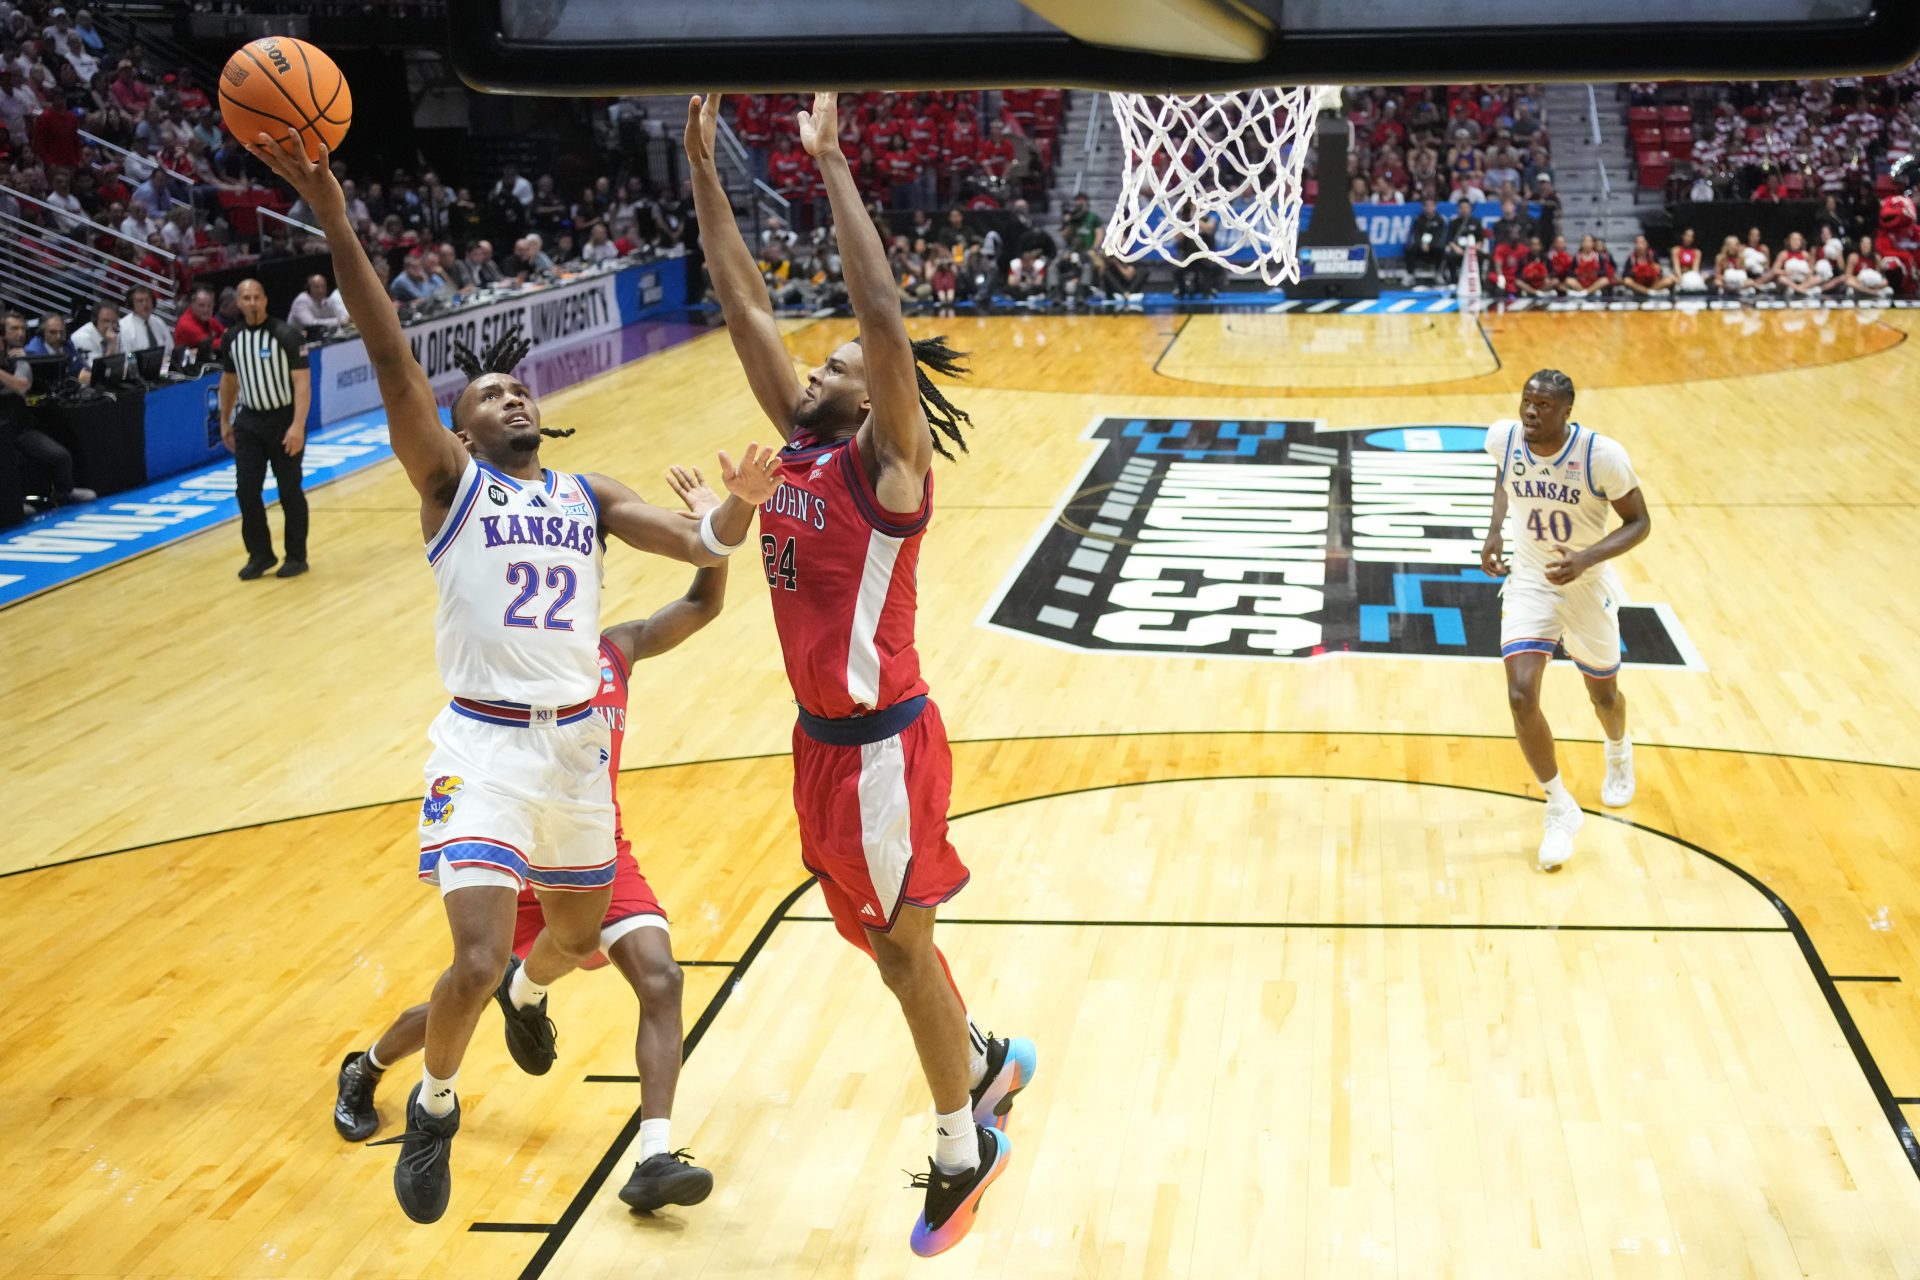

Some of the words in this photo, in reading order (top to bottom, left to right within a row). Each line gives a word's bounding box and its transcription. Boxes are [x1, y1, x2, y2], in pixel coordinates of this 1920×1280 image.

[427, 319, 476, 378] DIEGO
[531, 285, 610, 346] UNIVERSITY
[490, 487, 506, 503] SW
[1351, 449, 1514, 566] MARCH
[1511, 479, 1582, 506] KANSAS
[480, 514, 594, 556] KANSAS
[1526, 508, 1573, 543] 40
[760, 533, 797, 591] 24
[1092, 461, 1330, 651] MADNESS
[503, 561, 578, 632] 22
[536, 709, 553, 721] KU
[430, 802, 442, 813] KU
